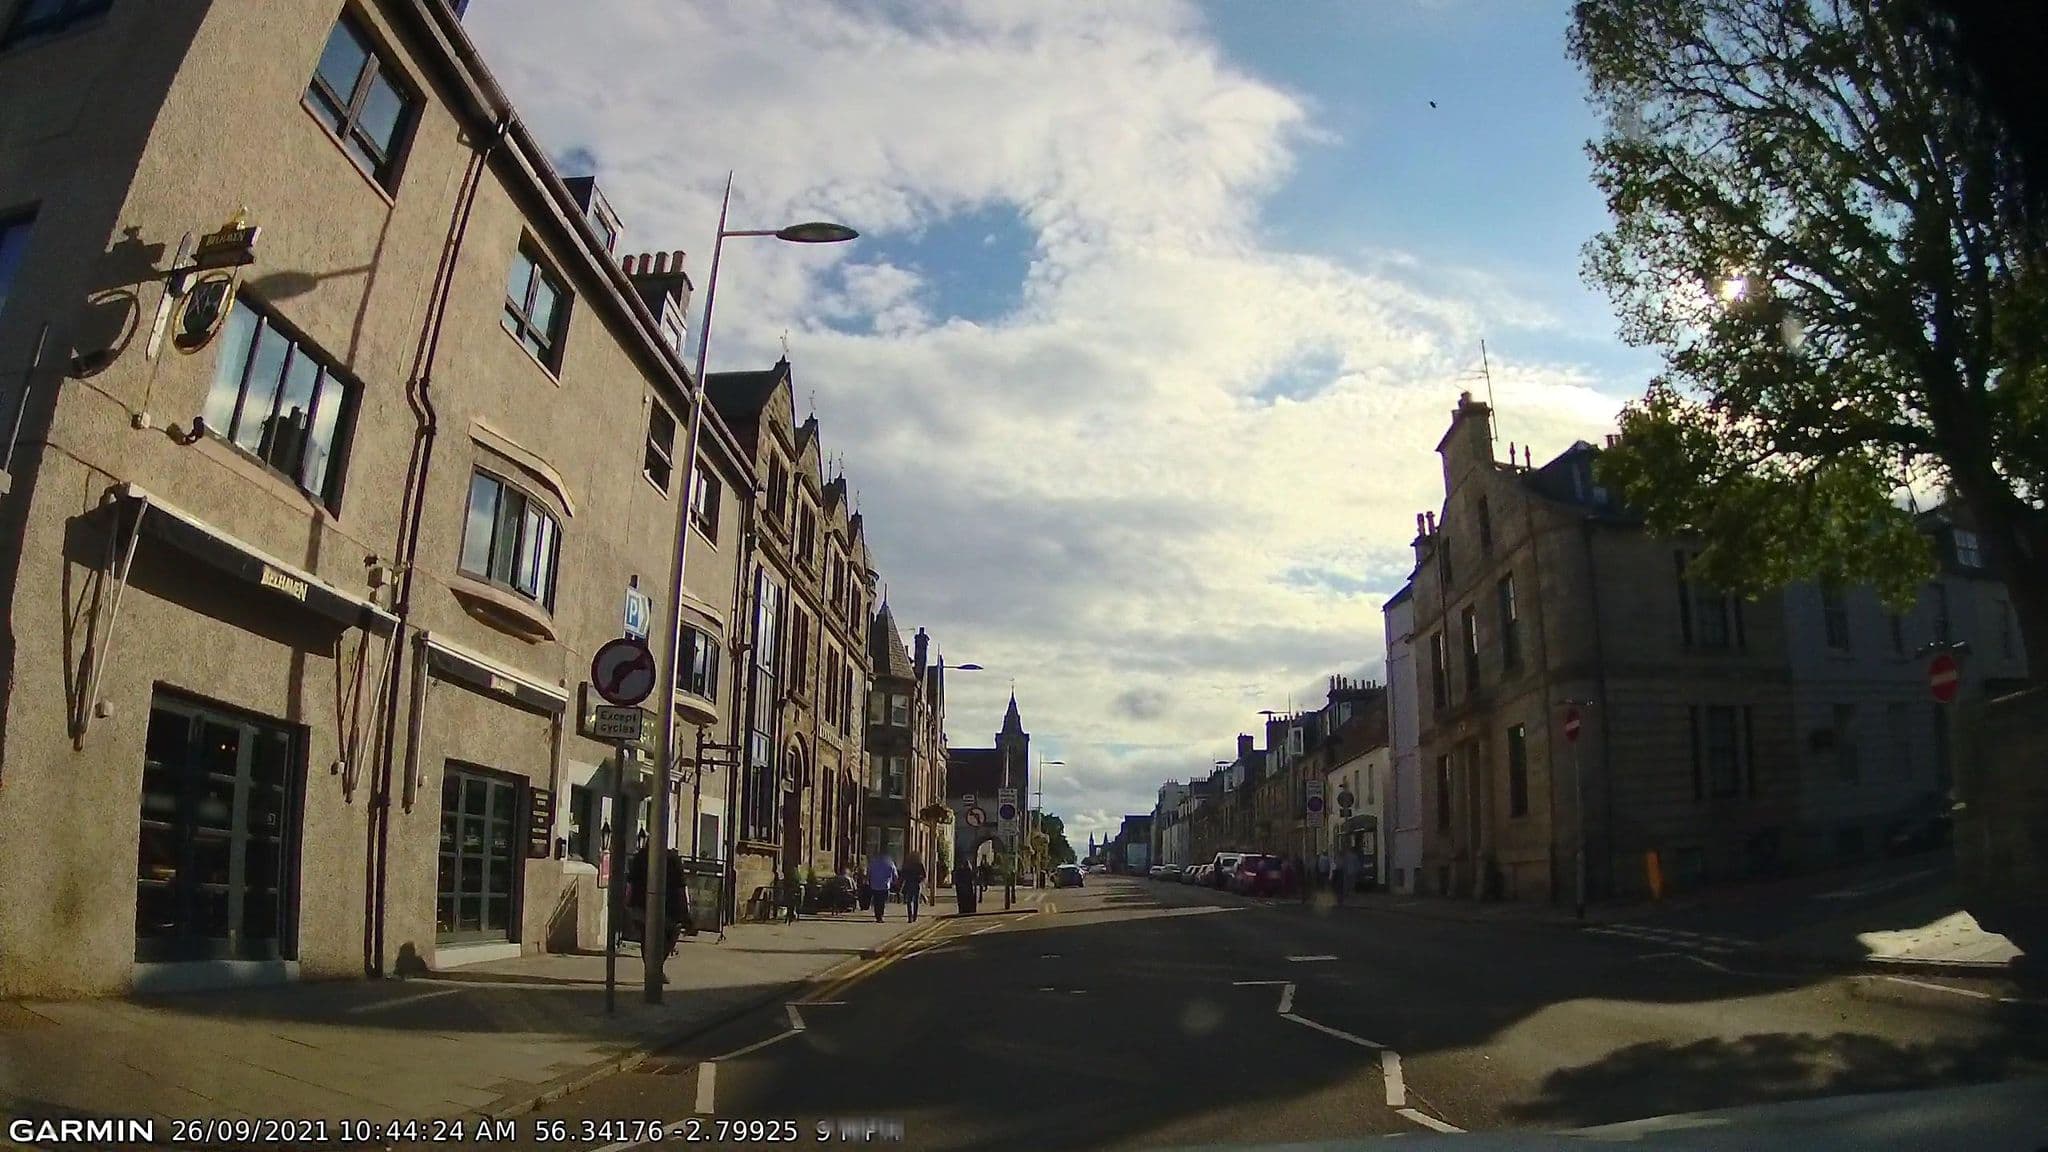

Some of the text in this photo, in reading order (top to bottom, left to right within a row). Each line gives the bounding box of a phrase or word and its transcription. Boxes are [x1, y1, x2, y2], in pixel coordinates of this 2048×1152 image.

[628, 600, 638, 624] P
[601, 711, 637, 723] Except
[600, 724, 635, 734] cycles
